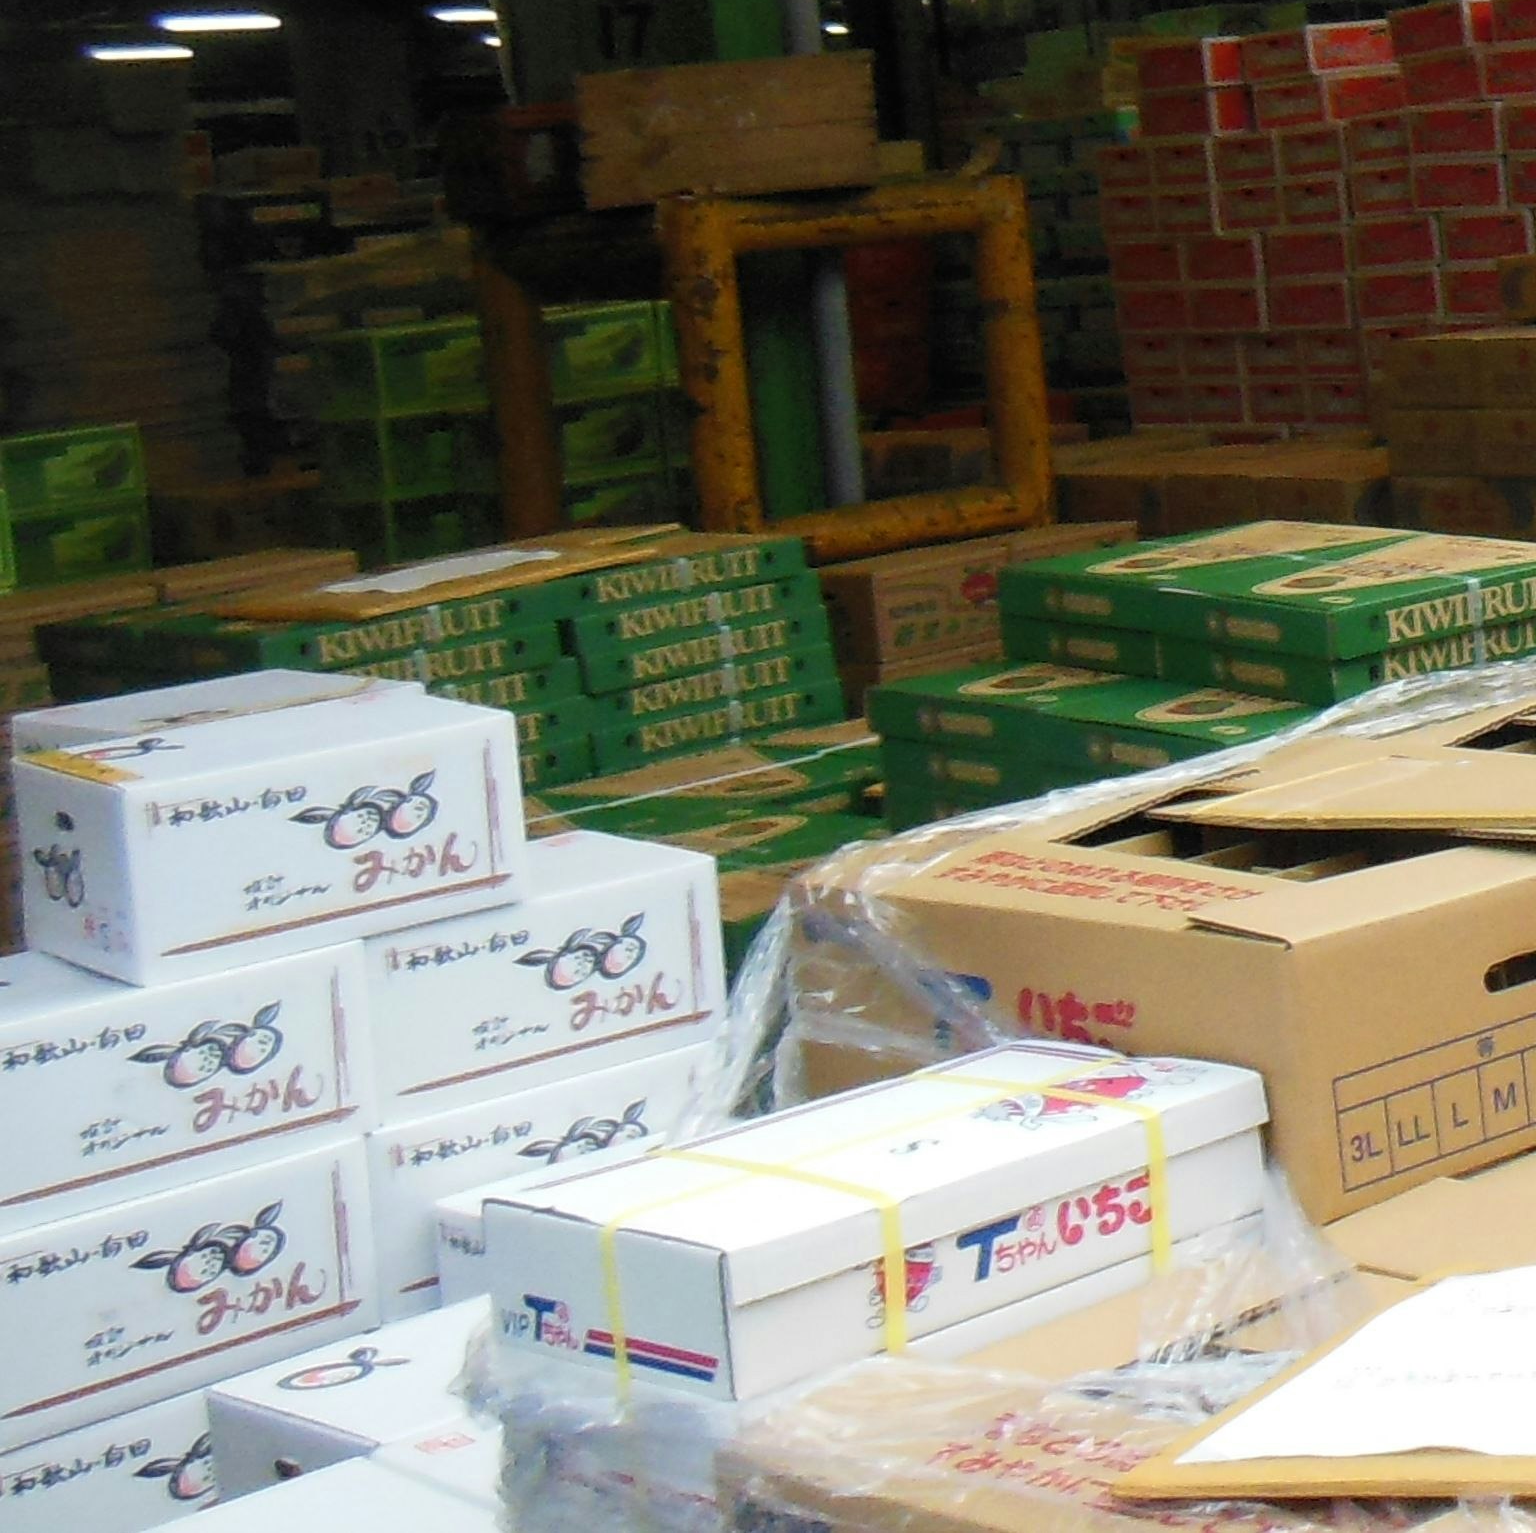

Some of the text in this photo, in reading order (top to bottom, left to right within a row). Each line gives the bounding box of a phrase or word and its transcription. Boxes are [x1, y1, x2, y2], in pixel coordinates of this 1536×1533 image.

[354, 831, 477, 893] みかん
[570, 971, 681, 1031] みかん
[193, 1065, 324, 1134] みかん
[1351, 1135, 1383, 1164] 3L
[1396, 1112, 1431, 1144] LL
[1449, 1099, 1469, 1128] L
[1493, 1083, 1517, 1113] M
[196, 1260, 326, 1336] みかん
